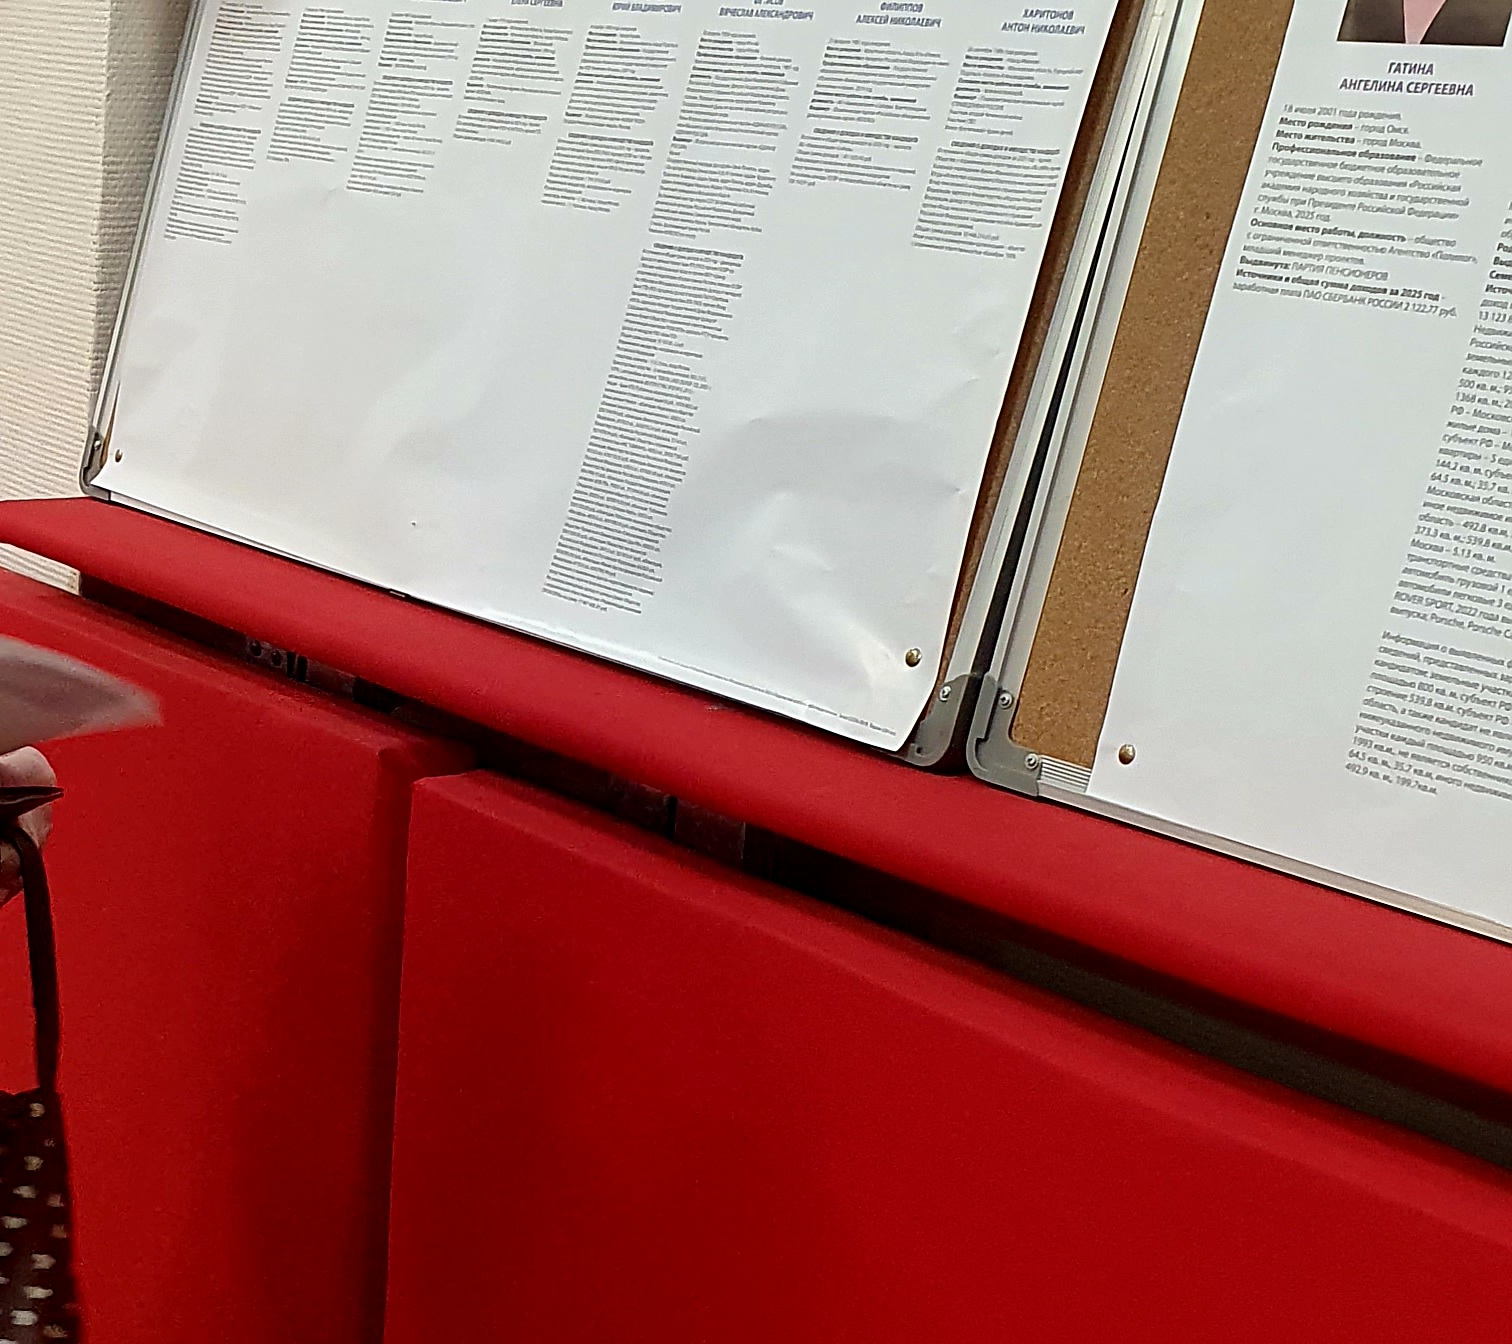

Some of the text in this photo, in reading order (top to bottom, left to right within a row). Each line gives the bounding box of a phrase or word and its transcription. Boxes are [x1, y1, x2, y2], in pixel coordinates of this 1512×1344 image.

[1022, 9, 1074, 20] ХАРИТОНОВ
[1387, 61, 1434, 76] ГАТИНА
[1338, 78, 1474, 97] АНГЕЛИНА СЕРГЕЕВНА
[1400, 288, 1423, 301] 2025
